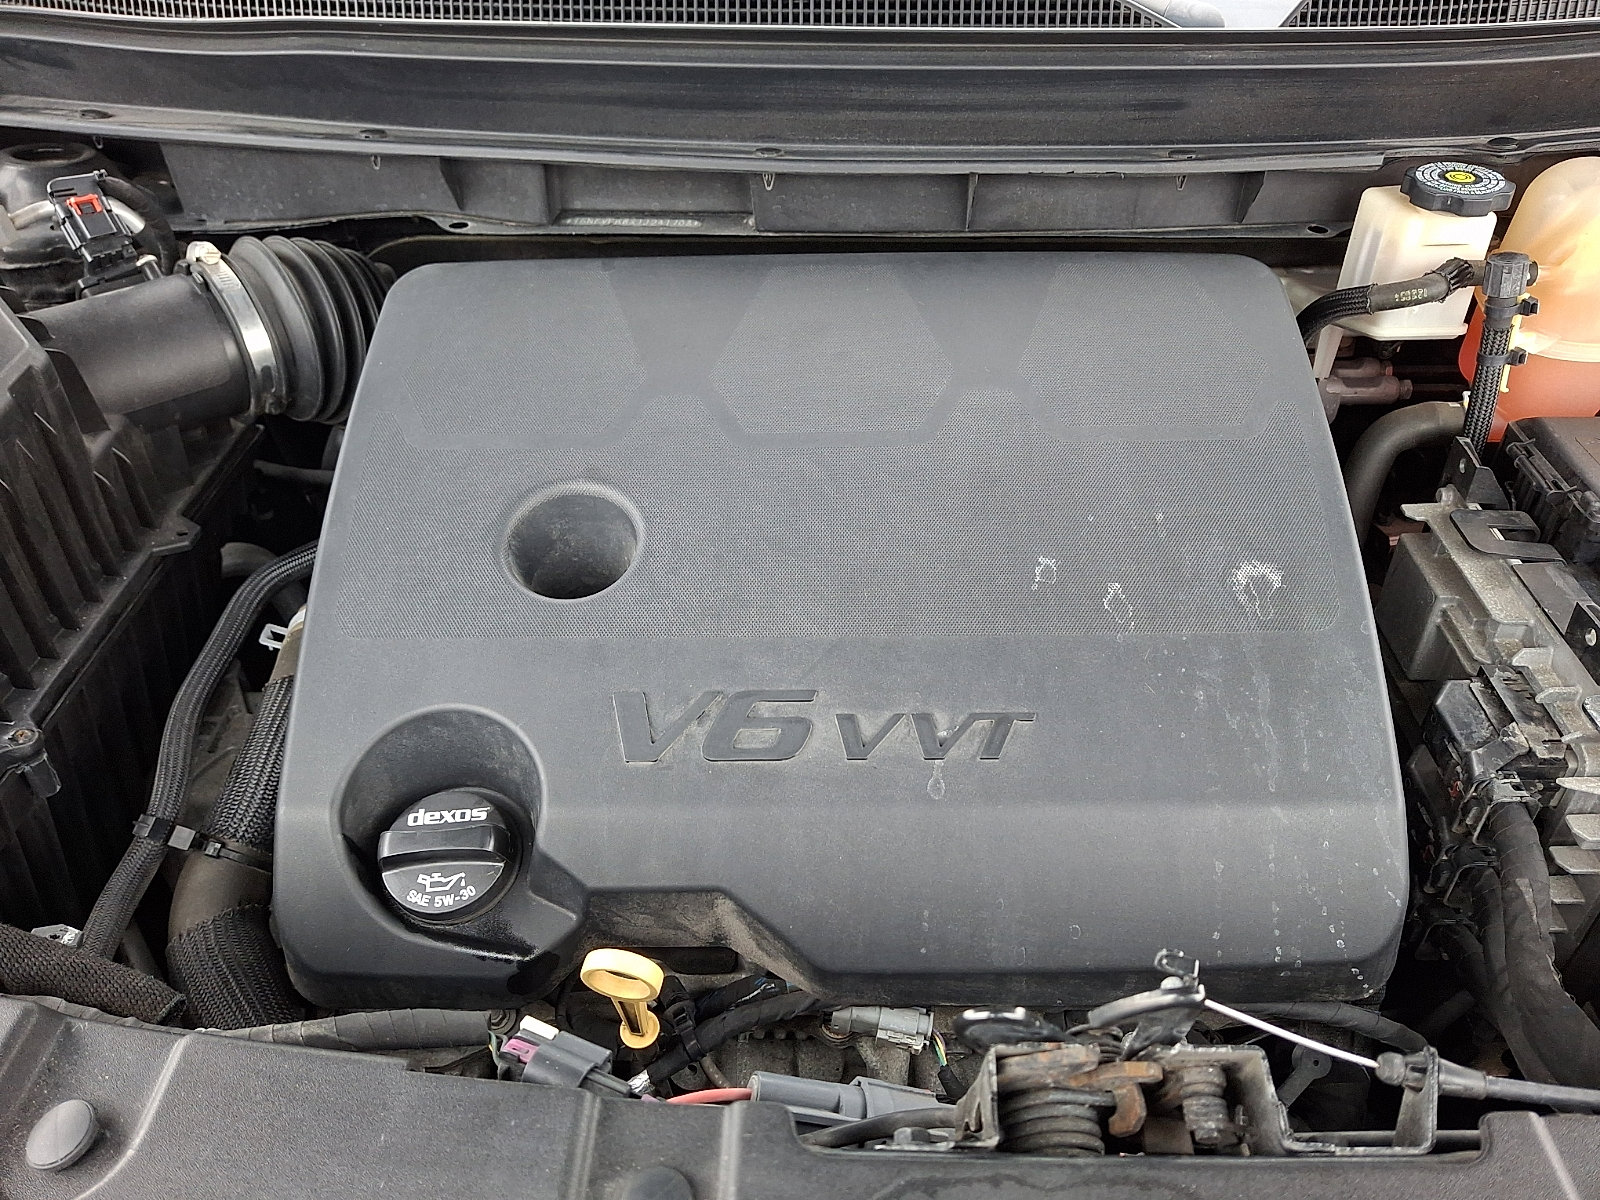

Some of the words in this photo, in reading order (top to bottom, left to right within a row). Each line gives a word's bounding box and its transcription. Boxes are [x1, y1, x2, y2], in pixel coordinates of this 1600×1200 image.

[612, 689, 818, 763] V6
[835, 713, 1037, 760] VVT
[407, 806, 490, 827] dexos
[407, 889, 432, 907] SAE
[433, 885, 477, 908] 5W-30
